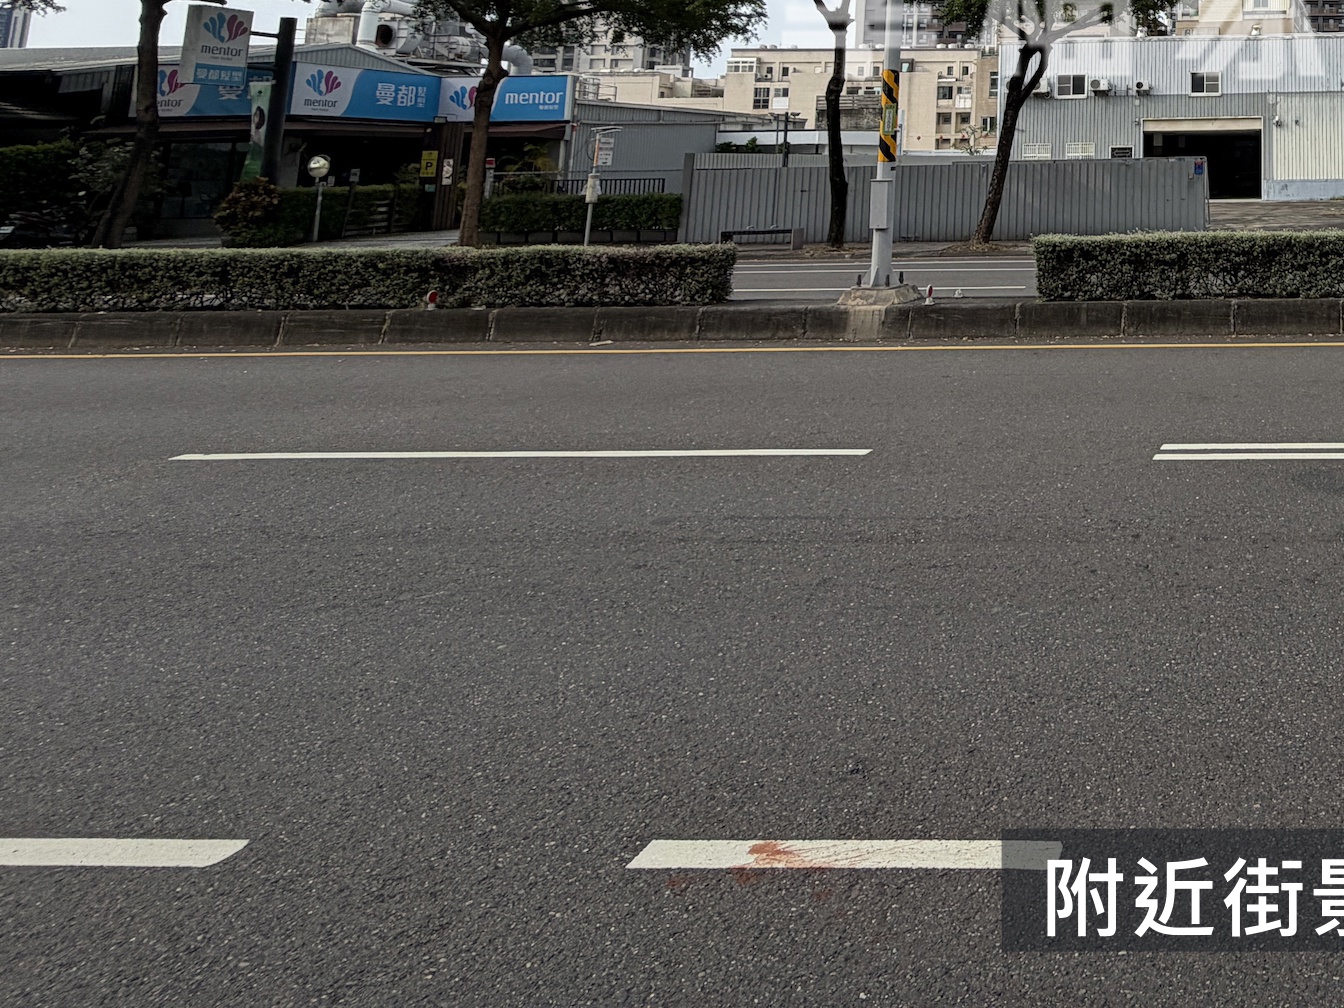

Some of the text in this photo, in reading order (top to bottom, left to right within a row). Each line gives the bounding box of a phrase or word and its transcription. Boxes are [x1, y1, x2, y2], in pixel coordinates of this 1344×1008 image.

[201, 44, 243, 57] mentor
[303, 98, 338, 108] mentor
[504, 91, 563, 105] mentor
[425, 161, 433, 170] P
